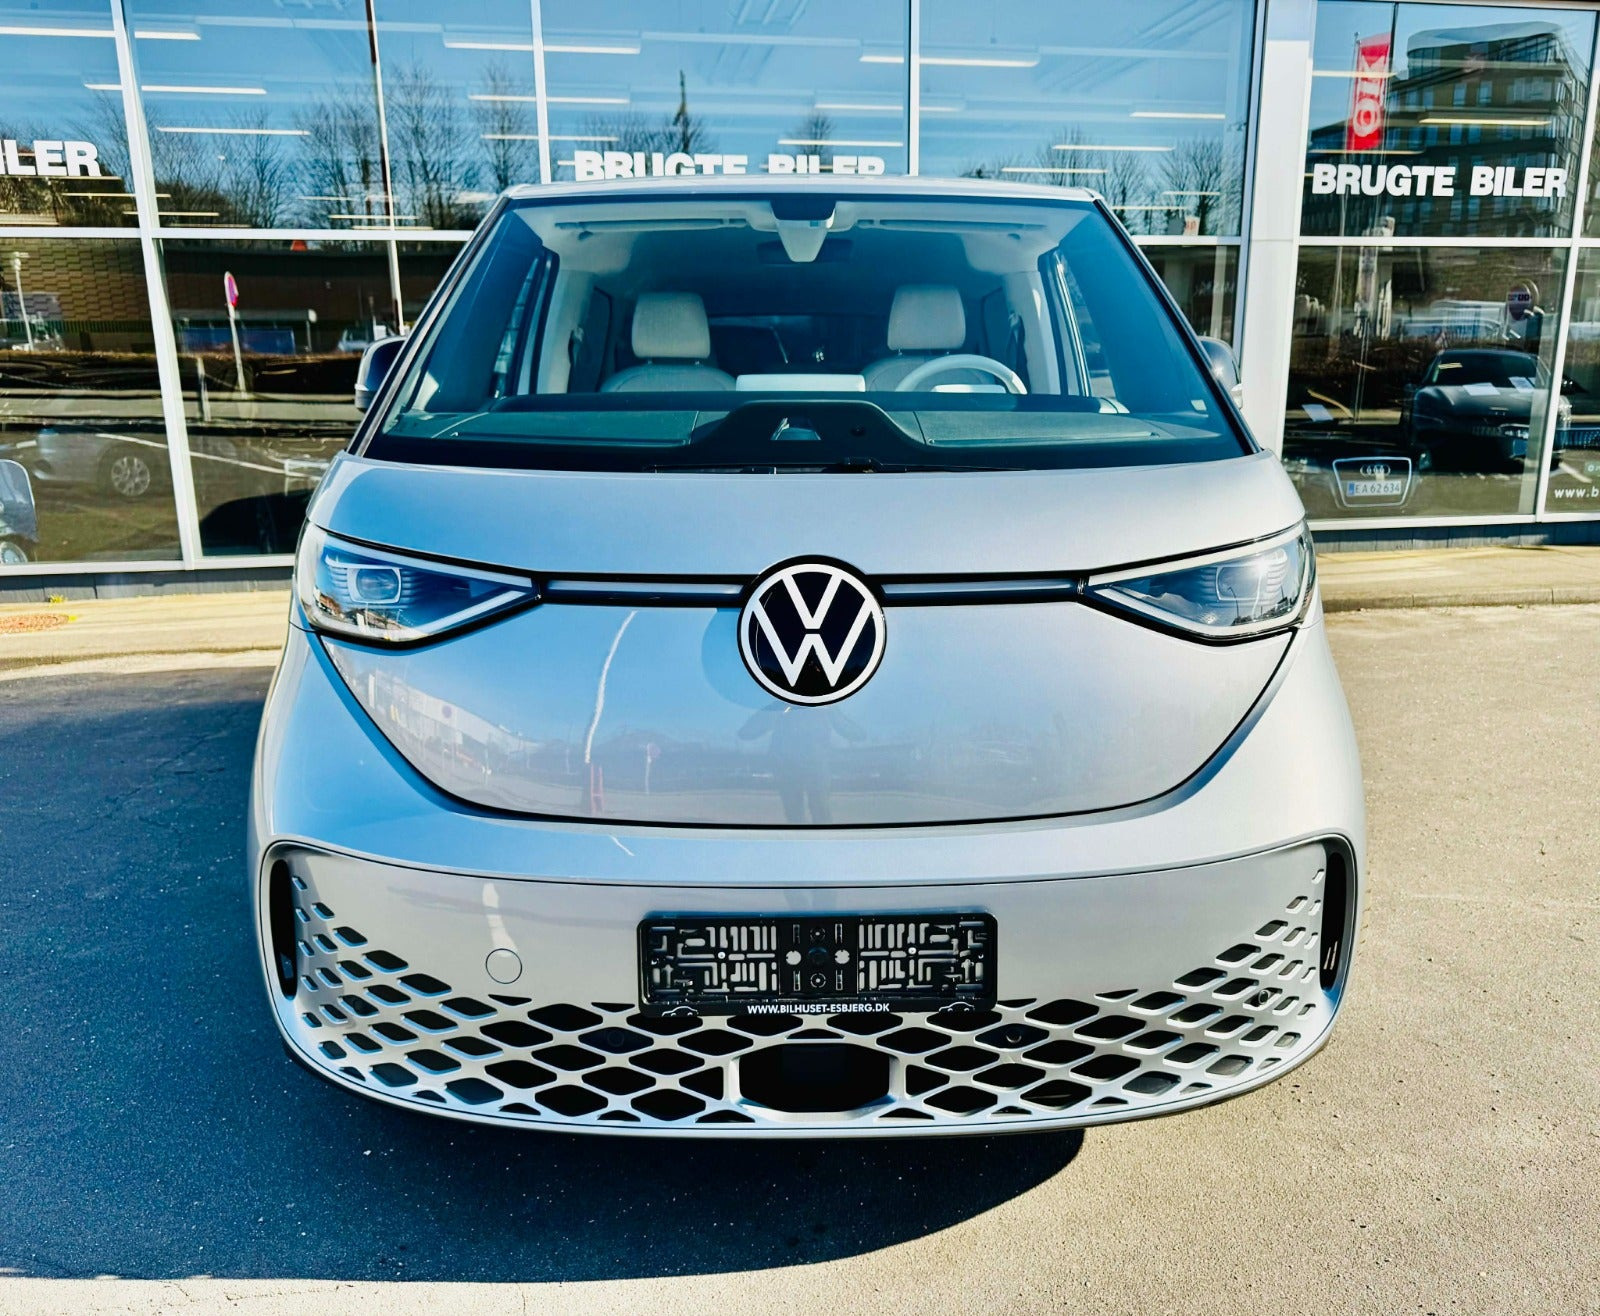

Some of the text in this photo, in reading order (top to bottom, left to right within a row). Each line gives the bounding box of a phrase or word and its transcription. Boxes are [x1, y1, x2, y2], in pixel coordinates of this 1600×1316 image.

[1312, 163, 1569, 198] BRUGTE BILER
[747, 1003, 890, 1014] WWW.BILHUSET-ESBJERG.DK
